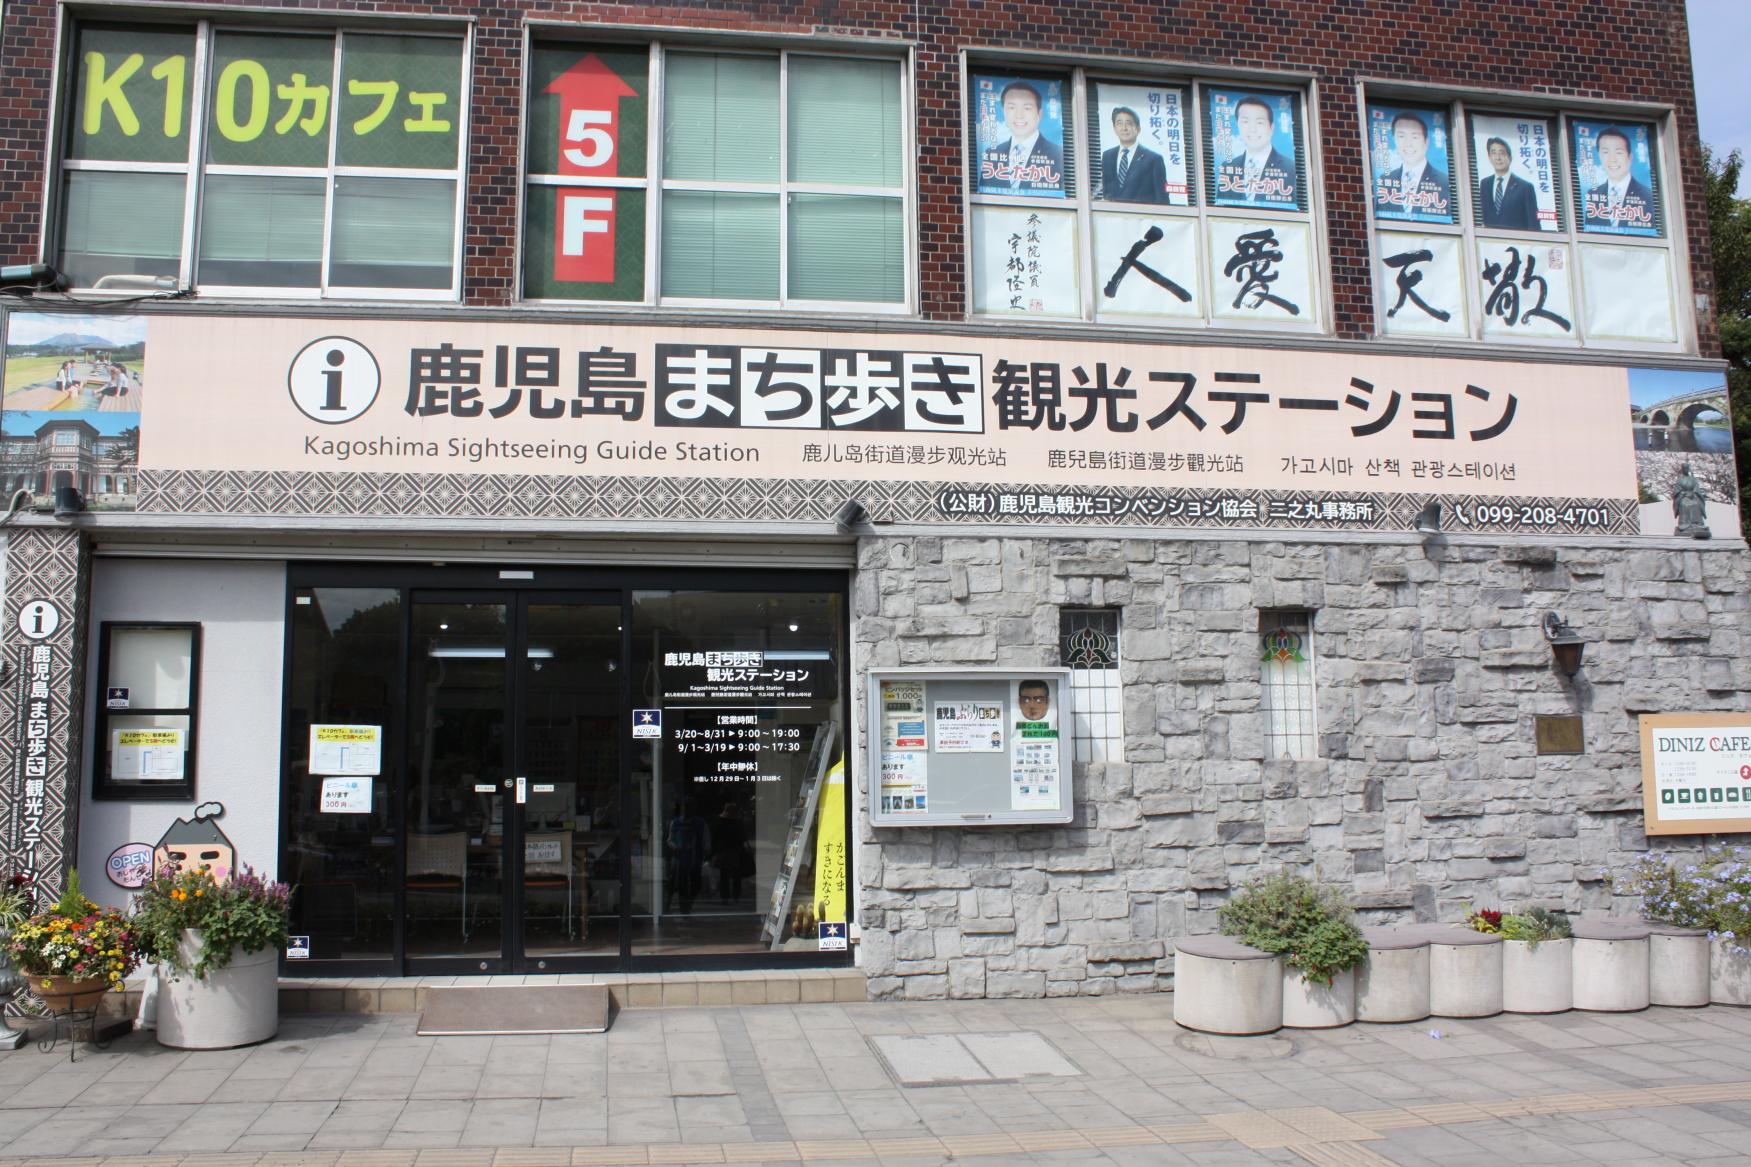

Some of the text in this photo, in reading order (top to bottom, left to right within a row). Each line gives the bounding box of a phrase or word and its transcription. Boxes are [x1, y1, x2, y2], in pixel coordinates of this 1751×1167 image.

[84, 51, 451, 142] K10カフェ
[1166, 93, 1180, 165] 日本の明日を
[1533, 125, 1549, 192] 日本の明日を
[981, 161, 1060, 183] うとたかし
[1218, 175, 1292, 195] うとたかし
[1376, 187, 1447, 208] うとたかし
[1586, 201, 1652, 221] うとたかし
[304, 436, 760, 464] Kagoshima Sightseeing Guide Station
[802, 443, 1006, 467] 鹿儿岛街道漫步观光站
[1048, 450, 1244, 473] 鹿兒島街道漫步觀光站
[1281, 456, 1516, 481] 가고시마 산책 관광스테이션
[1270, 500, 1374, 522] 二之丸事務所
[1477, 505, 1609, 526] 099-208-4701
[665, 652, 763, 667] 鹿児島まち歩き
[707, 668, 809, 682] 観光ステーション
[1658, 736, 1750, 752] DINIZ CAFE
[111, 849, 151, 870] OPEN
[822, 842, 833, 906] すきになる
